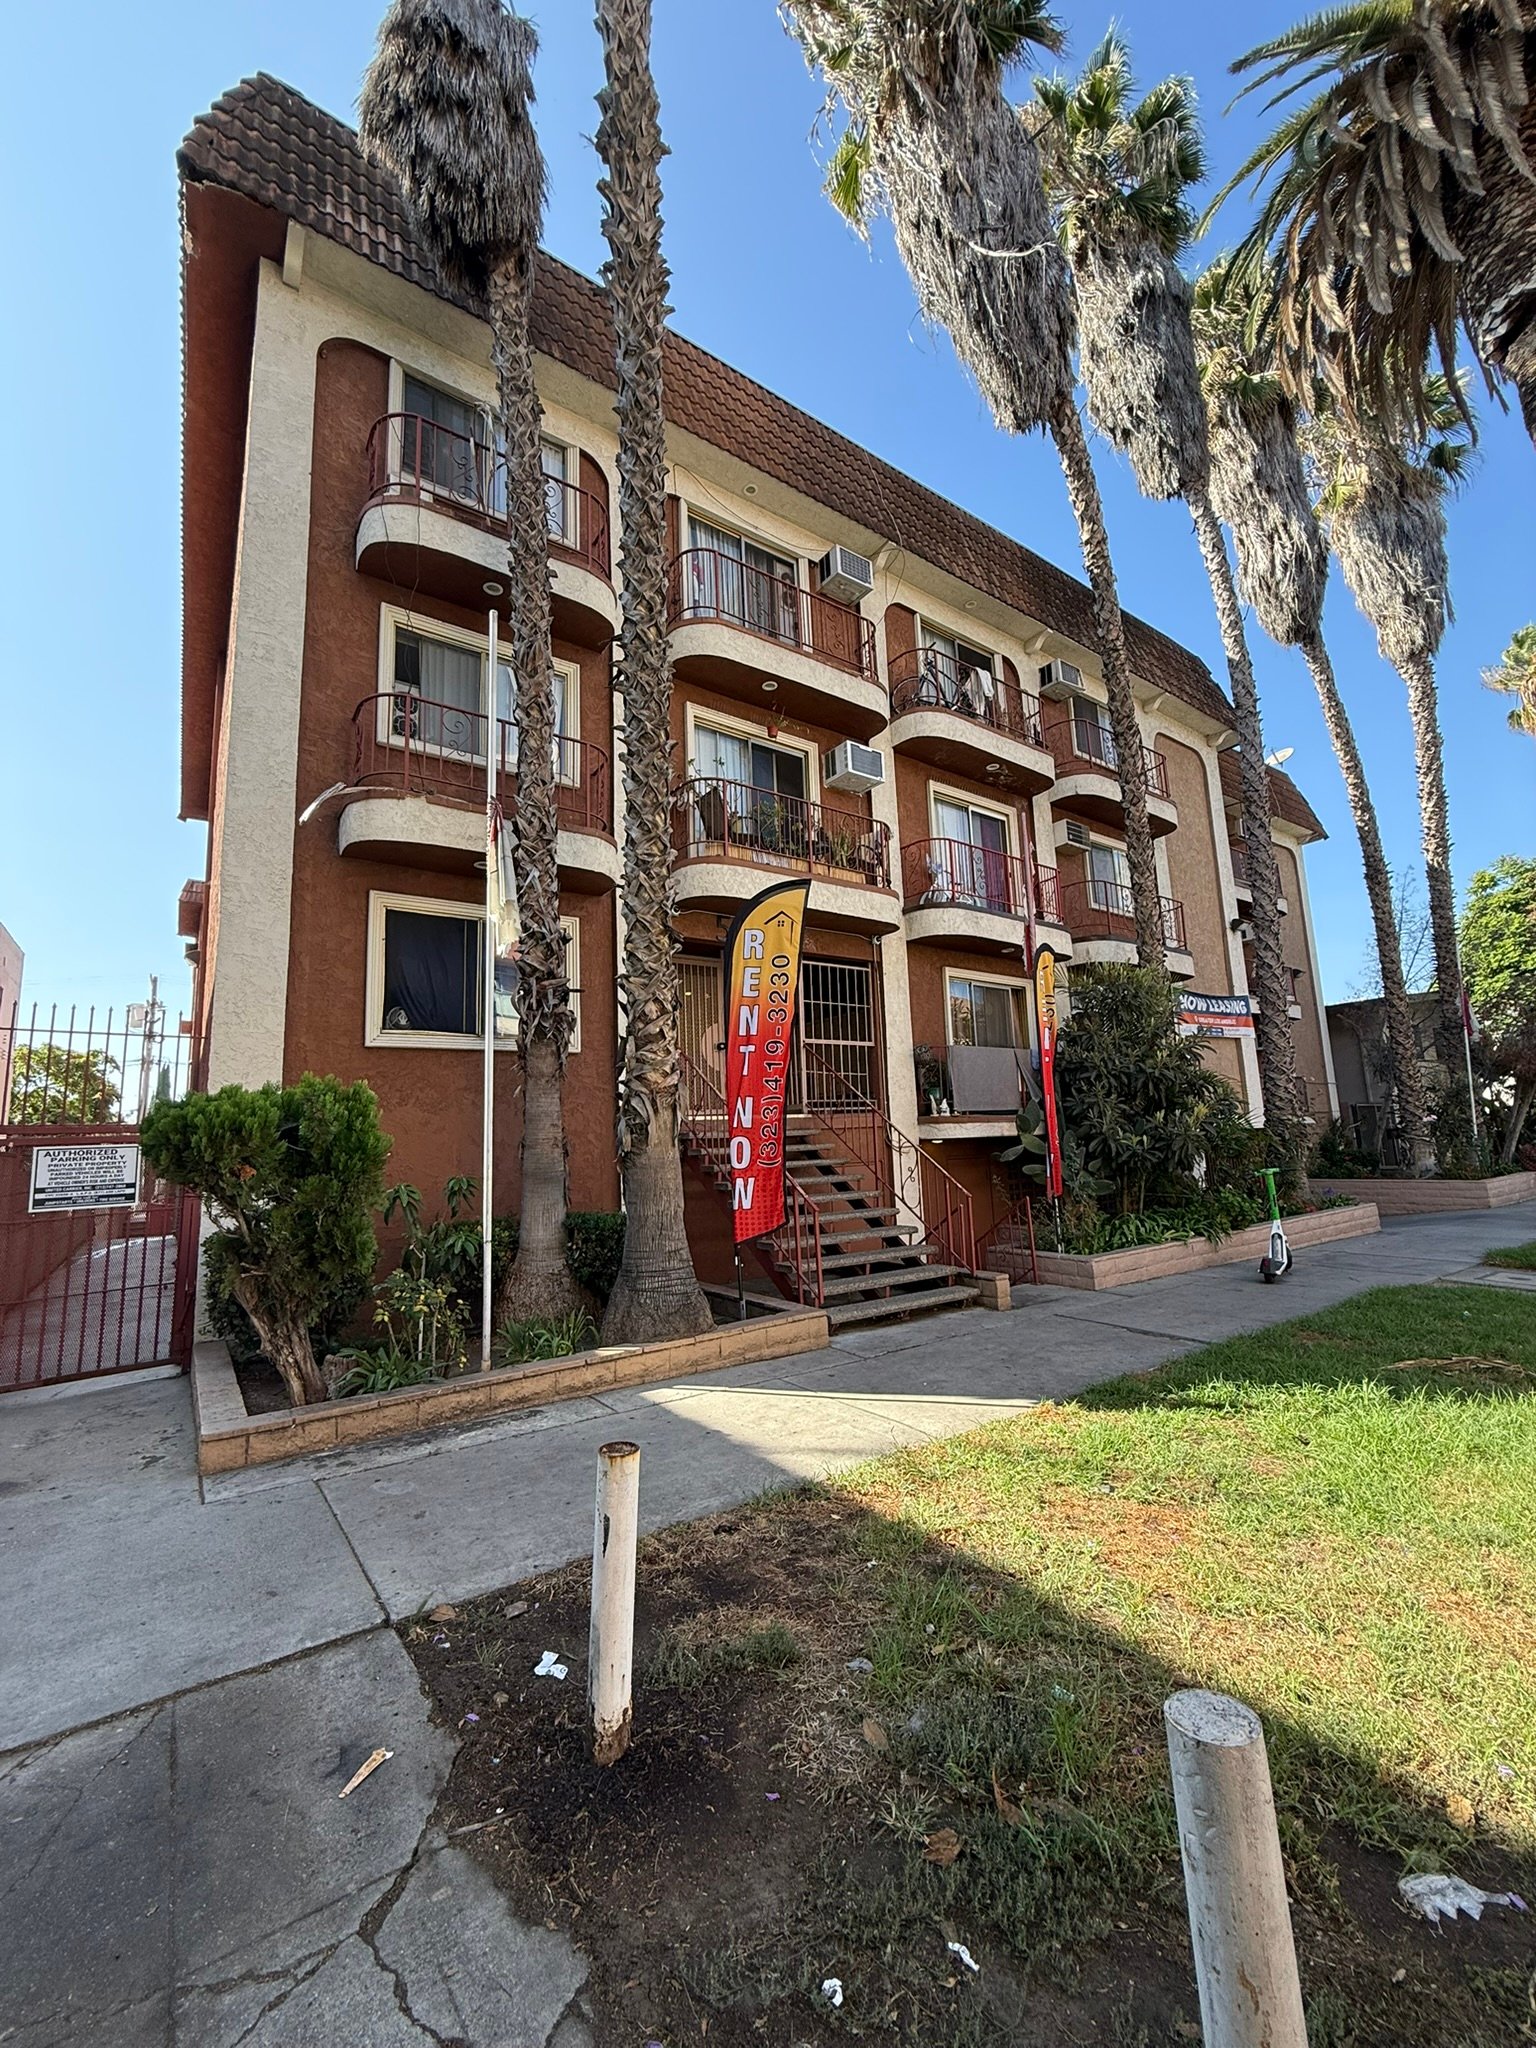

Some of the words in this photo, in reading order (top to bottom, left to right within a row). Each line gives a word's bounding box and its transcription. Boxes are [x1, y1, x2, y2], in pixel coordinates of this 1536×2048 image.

[738, 927, 765, 1076] RENT
[1179, 994, 1207, 1011] NOW
[1207, 999, 1248, 1014] LEASING
[757, 954, 791, 1168] (323)419-3230
[44, 1148, 118, 1158] AUTHORIZED
[730, 1096, 755, 1210] NOW
